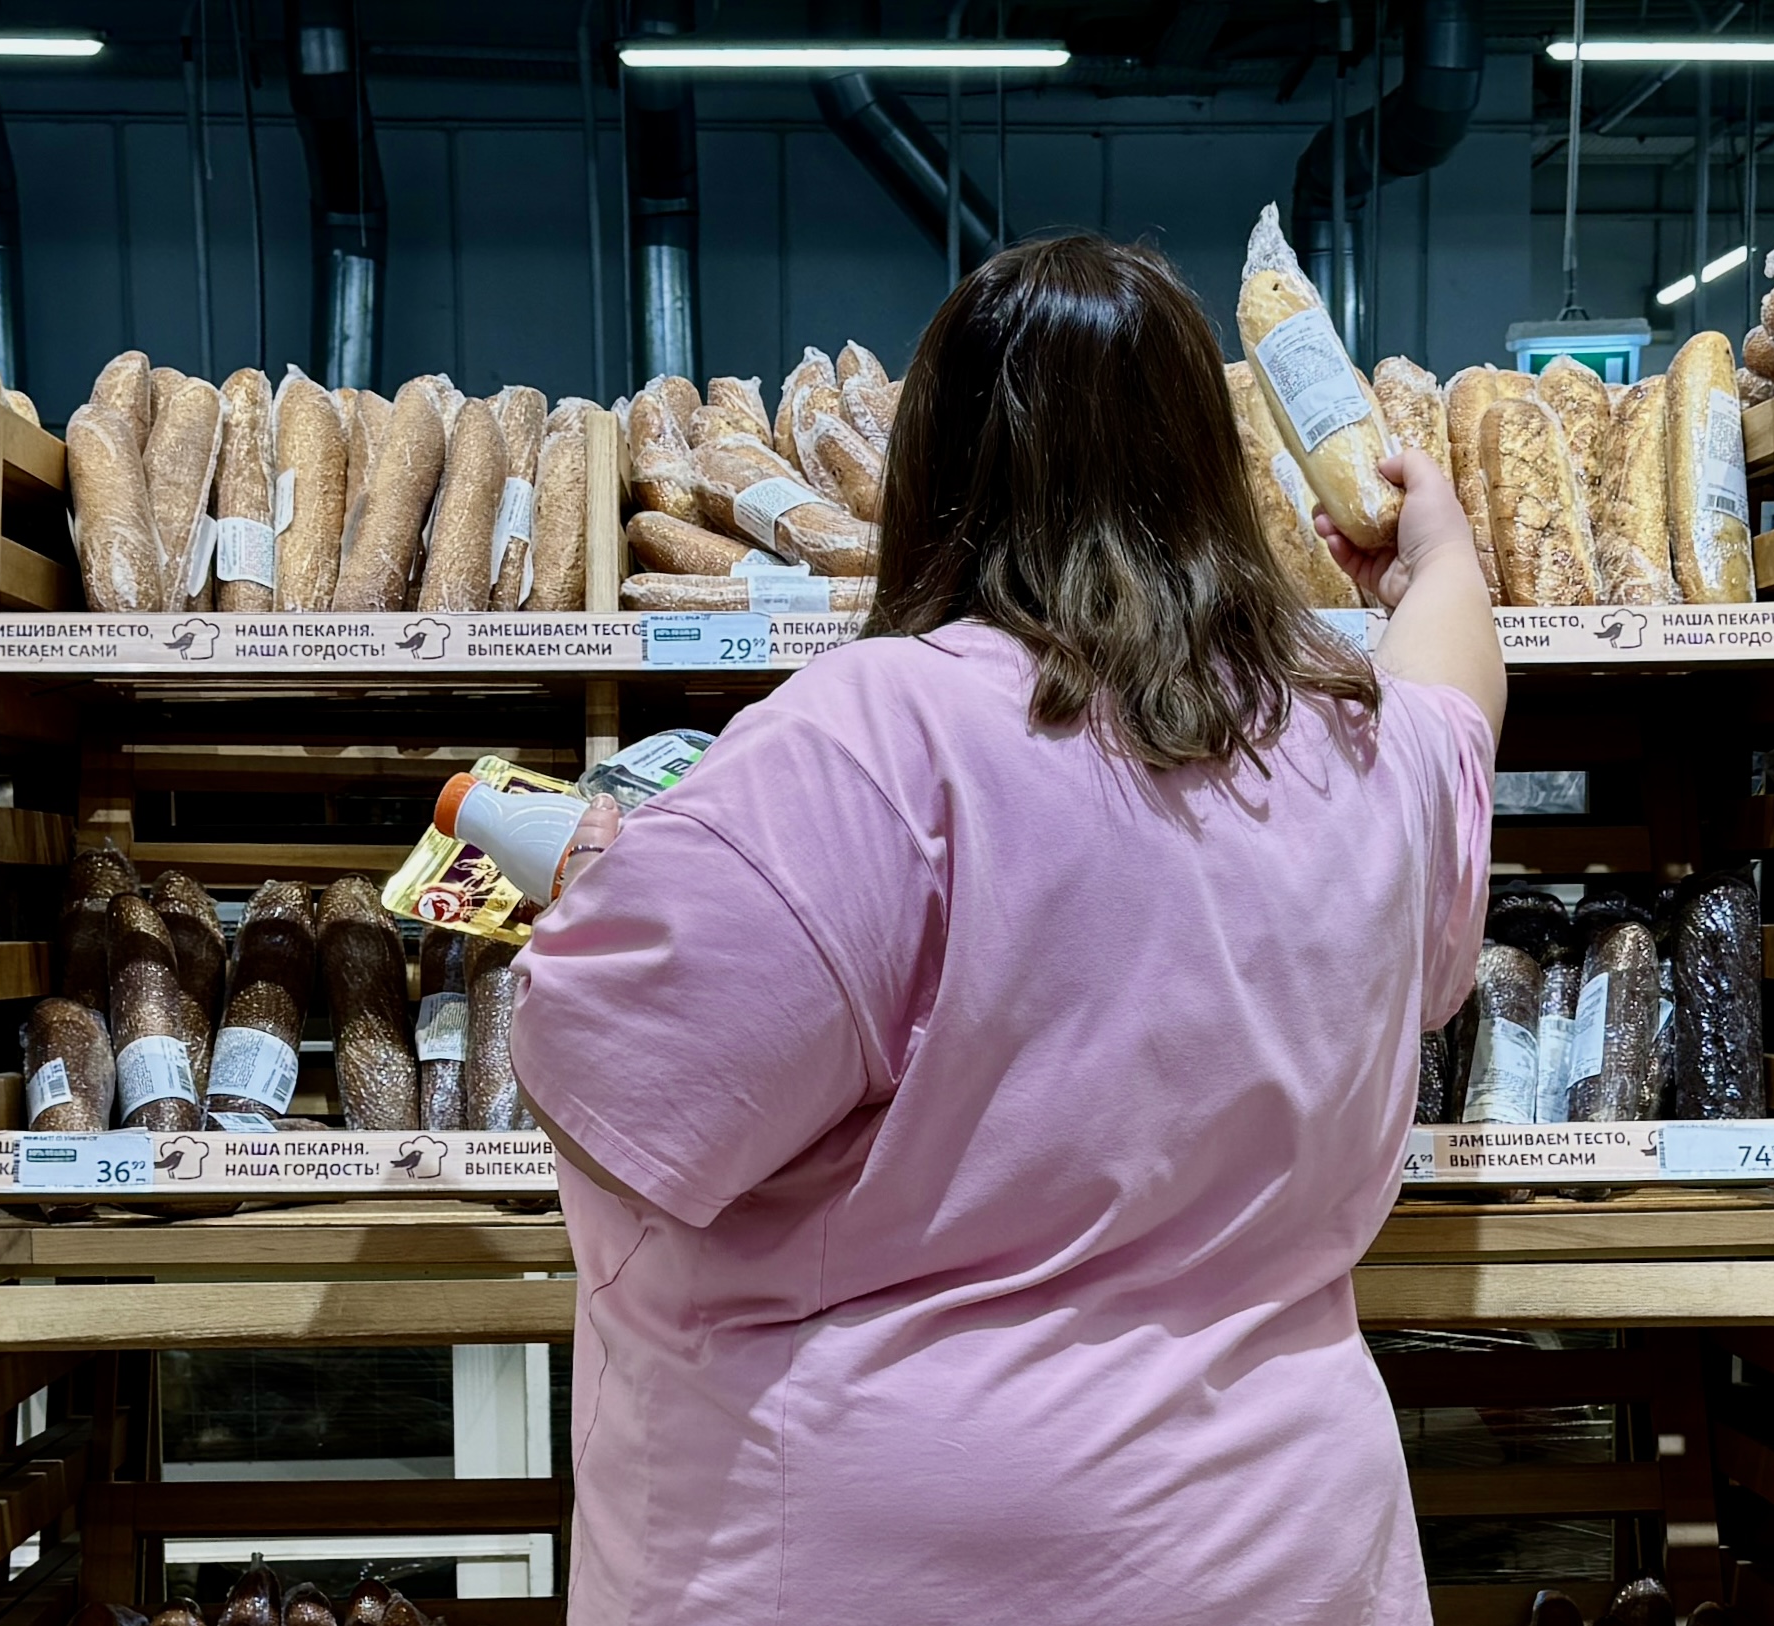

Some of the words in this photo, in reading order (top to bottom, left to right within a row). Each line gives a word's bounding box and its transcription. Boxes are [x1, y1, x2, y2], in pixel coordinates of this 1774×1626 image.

[1663, 614, 1713, 625] НАША
[96, 625, 153, 639] ТЕСТО,
[236, 625, 288, 636] НАША
[293, 625, 374, 637] ПЕКАРНЯ.
[468, 624, 587, 636] ЗАМЕШИВАЕМ
[1664, 633, 1715, 645] НАША
[69, 645, 116, 657] САМИ
[236, 645, 288, 656] НАША
[293, 644, 385, 660] ГОРДОСТЬ!
[468, 644, 560, 656] ВЫПЕКАЕМ
[565, 644, 611, 655] САМИ
[1448, 1133, 1569, 1147] ЗАМЕШИВАЕМ
[1574, 1132, 1630, 1146] ТЕСТО,
[226, 1143, 280, 1155] НАША
[285, 1143, 369, 1155] ПЕКАРНЯ.
[1450, 1154, 1542, 1167] ВЫПЕКАЕМ
[1548, 1153, 1595, 1165] САМИ
[226, 1164, 279, 1176] НАША
[285, 1163, 379, 1179] ГОРДОСТЬ!
